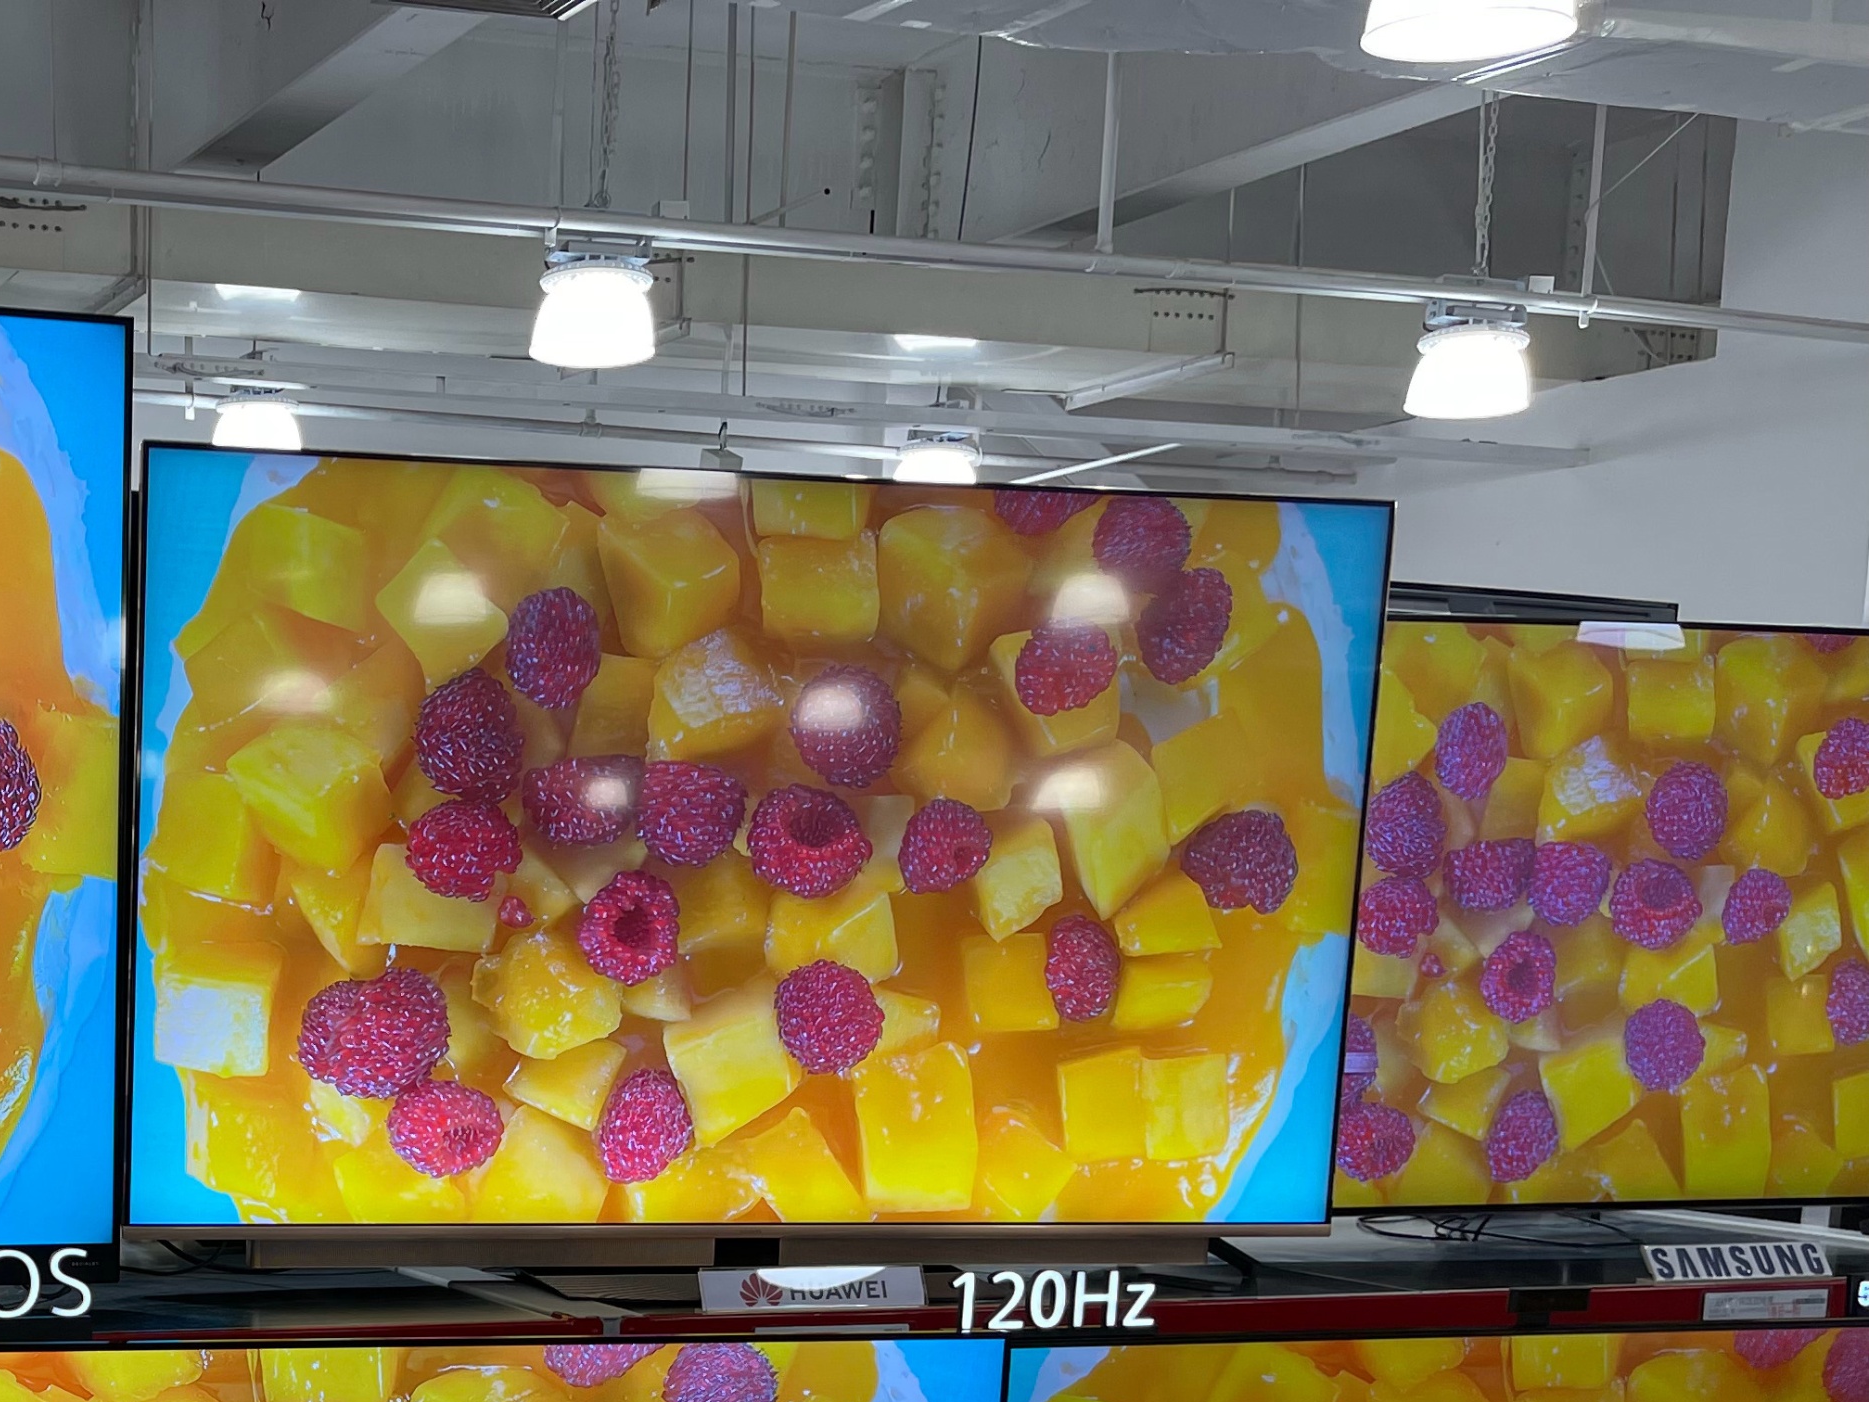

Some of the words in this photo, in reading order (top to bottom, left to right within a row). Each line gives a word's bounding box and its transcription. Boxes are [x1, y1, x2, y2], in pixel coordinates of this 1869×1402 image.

[1649, 1242, 1826, 1280] SAMSUNG
[790, 1280, 888, 1301] HUAWEI
[952, 1269, 1157, 1331] 120Hz
